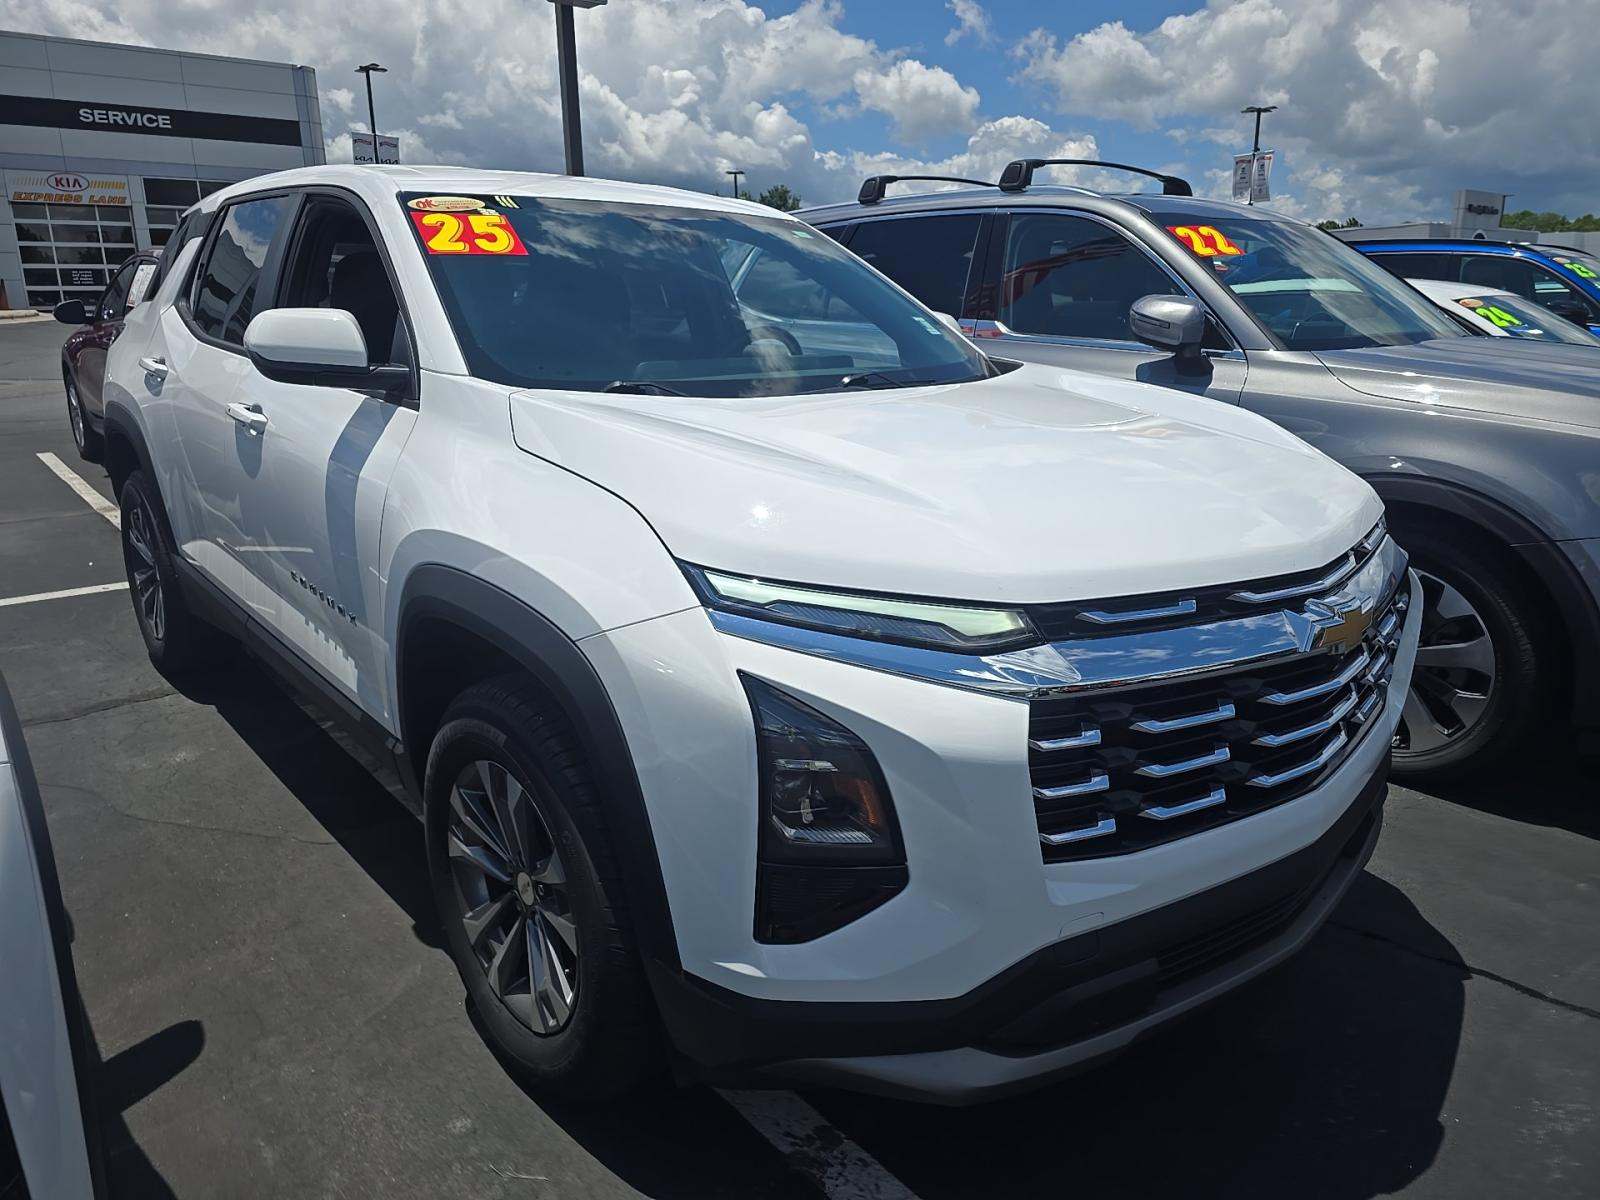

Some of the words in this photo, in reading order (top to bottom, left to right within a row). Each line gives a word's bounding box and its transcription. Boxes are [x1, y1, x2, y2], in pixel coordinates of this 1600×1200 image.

[78, 108, 172, 129] SERVICE
[54, 176, 82, 188] KIA
[13, 191, 83, 203] EXPRESS
[88, 194, 127, 205] LANE
[421, 212, 515, 254] 25
[1175, 226, 1242, 256] 22
[1475, 305, 1523, 328] 24
[290, 569, 358, 628] EQUINOX
